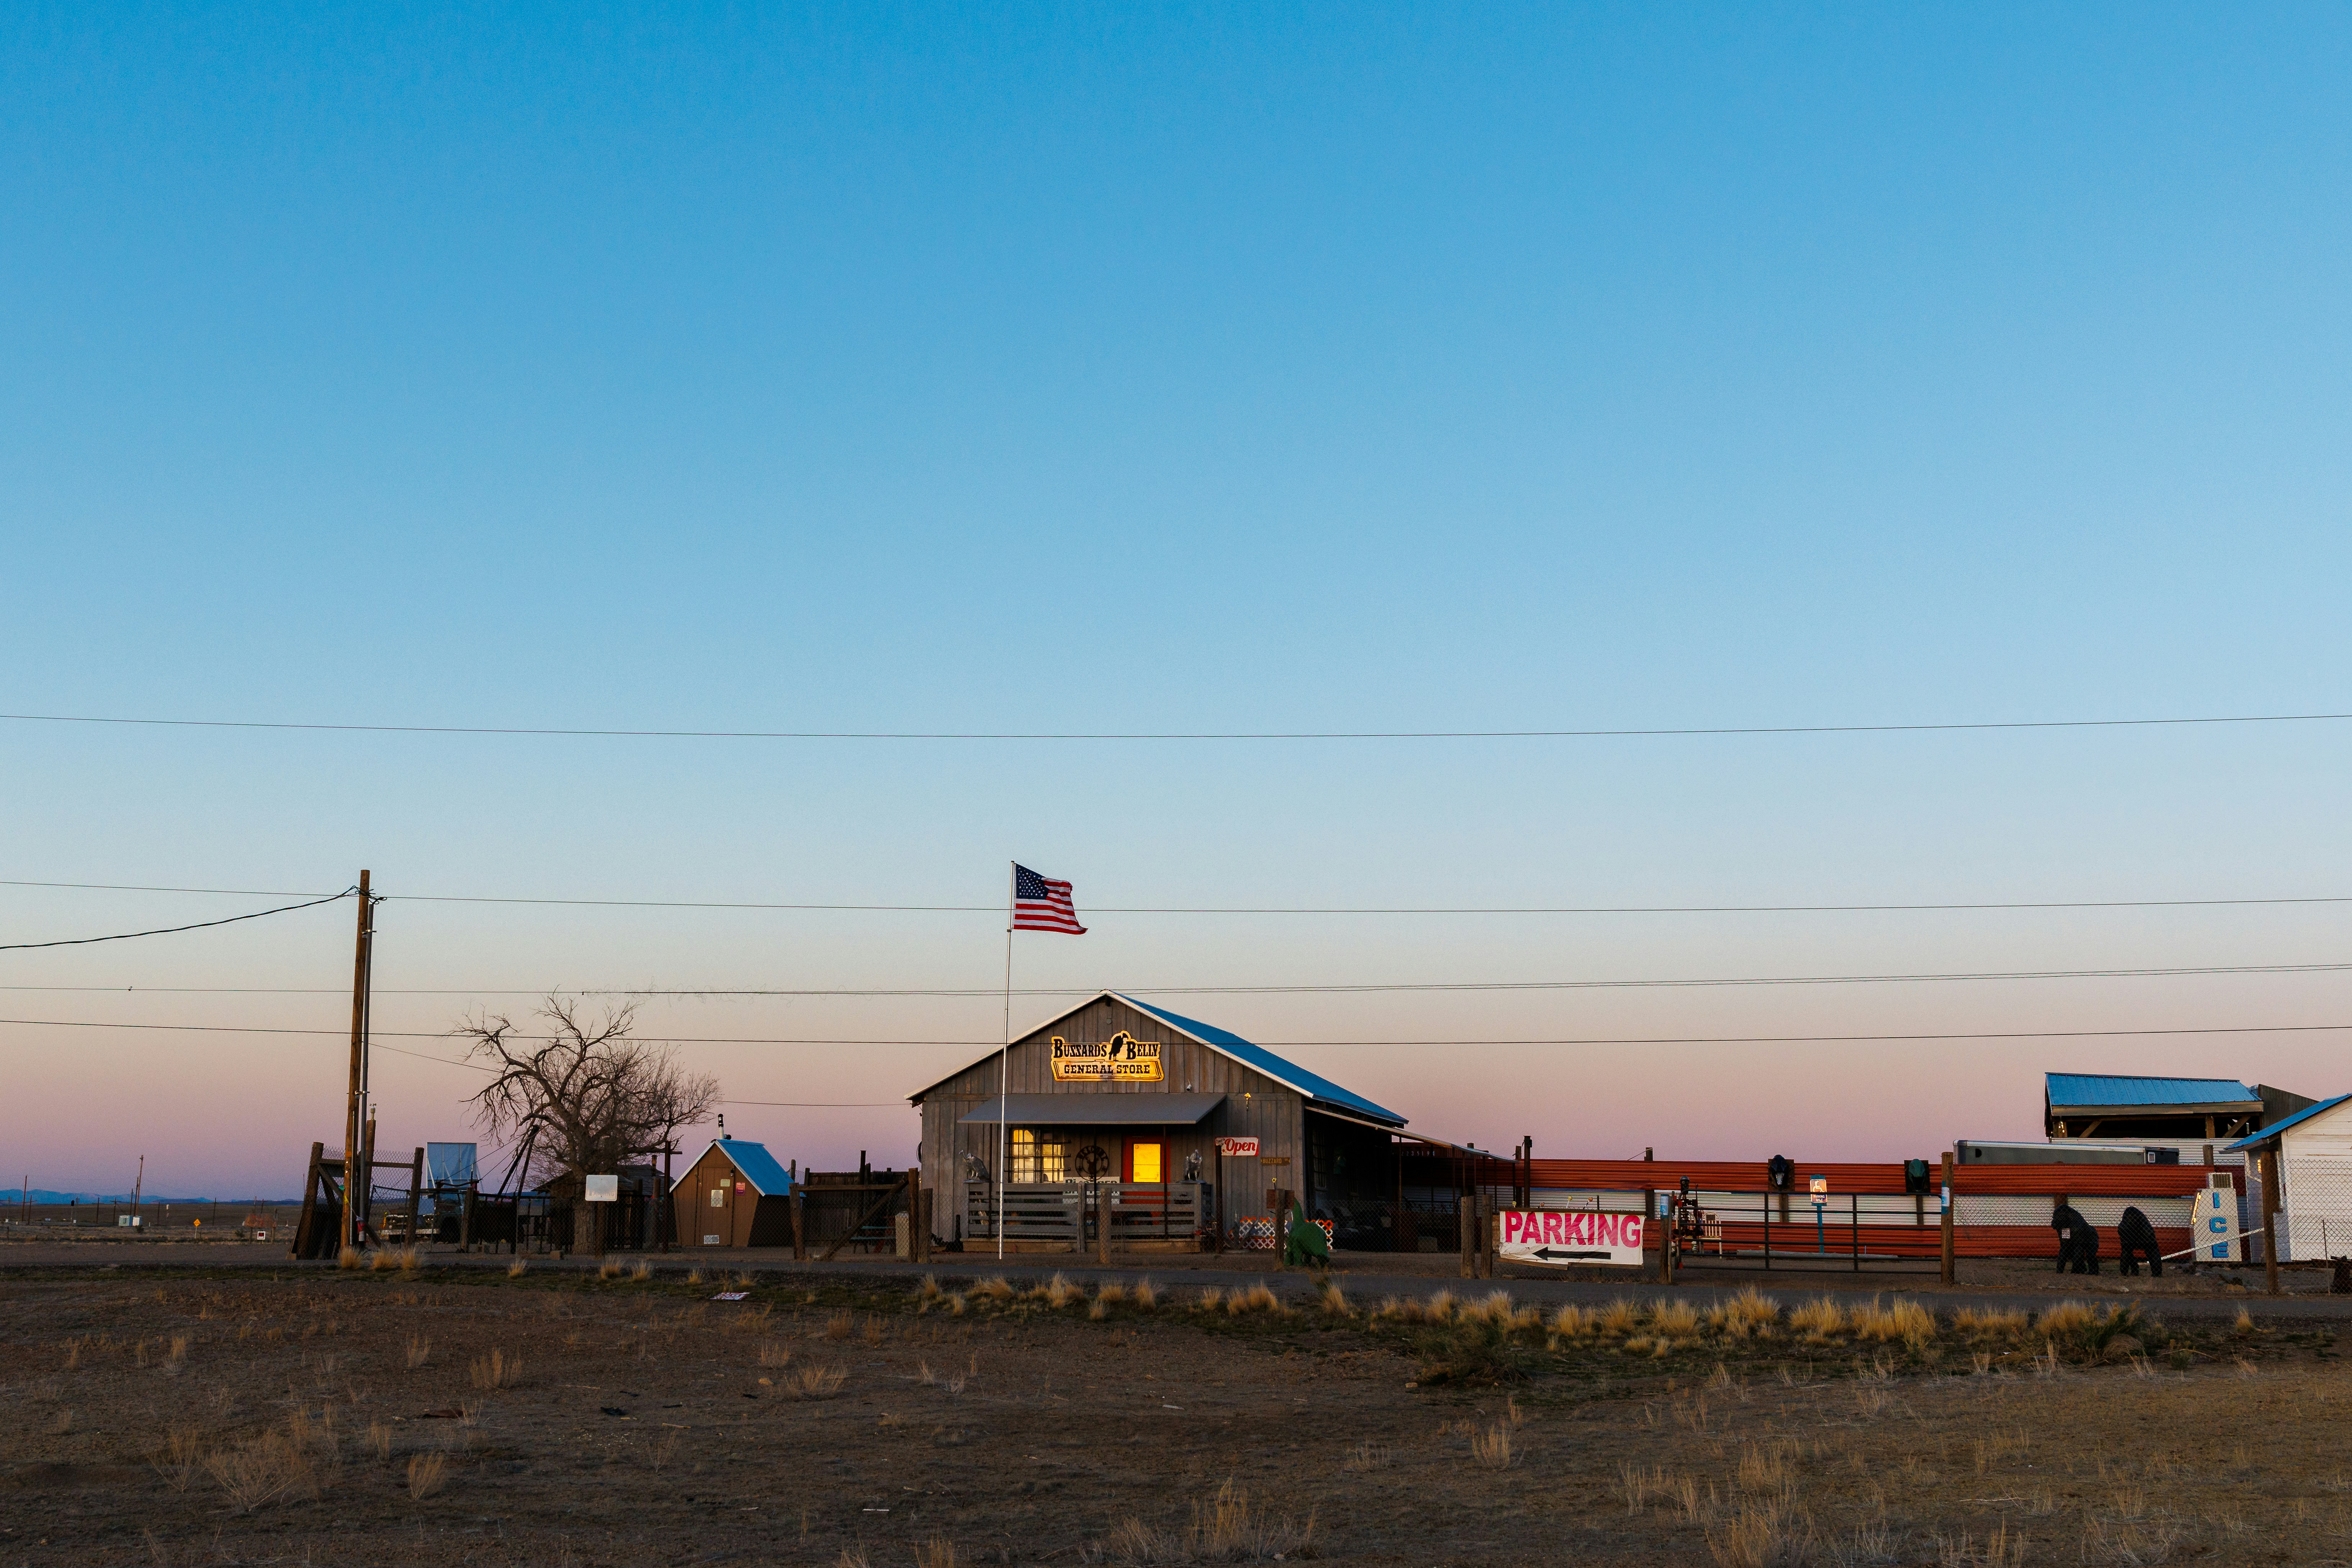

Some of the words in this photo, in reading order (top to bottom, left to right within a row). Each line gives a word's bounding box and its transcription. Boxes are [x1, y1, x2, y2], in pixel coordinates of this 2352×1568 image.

[1126, 1041, 1158, 1060] BELLY
[1064, 1065, 1113, 1074] GENERAL
[1116, 1065, 1150, 1074] STORE
[1224, 1138, 1255, 1155] Open
[1505, 1211, 1641, 1248] PARKING
[2209, 1192, 2229, 1258] ICE
